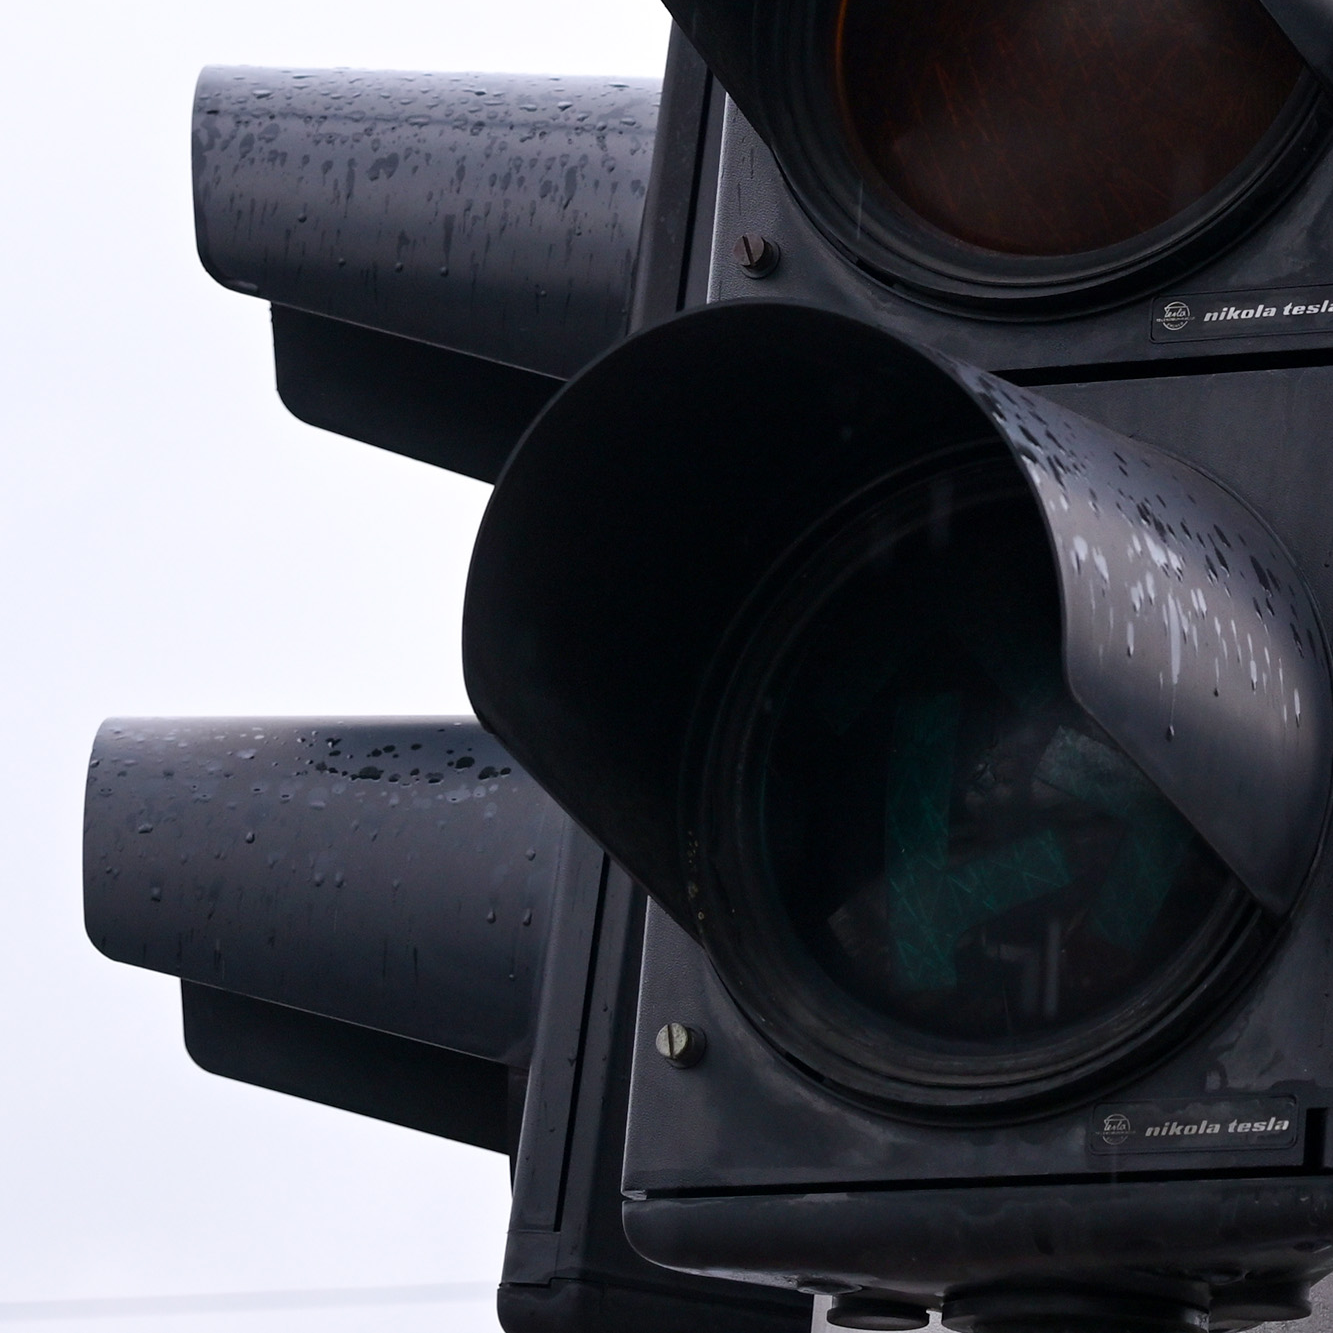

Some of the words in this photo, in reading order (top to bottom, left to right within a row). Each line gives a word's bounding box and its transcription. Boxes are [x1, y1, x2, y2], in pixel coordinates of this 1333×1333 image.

[1203, 303, 1277, 322] nikola
[1144, 1120, 1220, 1137] nikola
[1227, 1116, 1290, 1133] tesla
